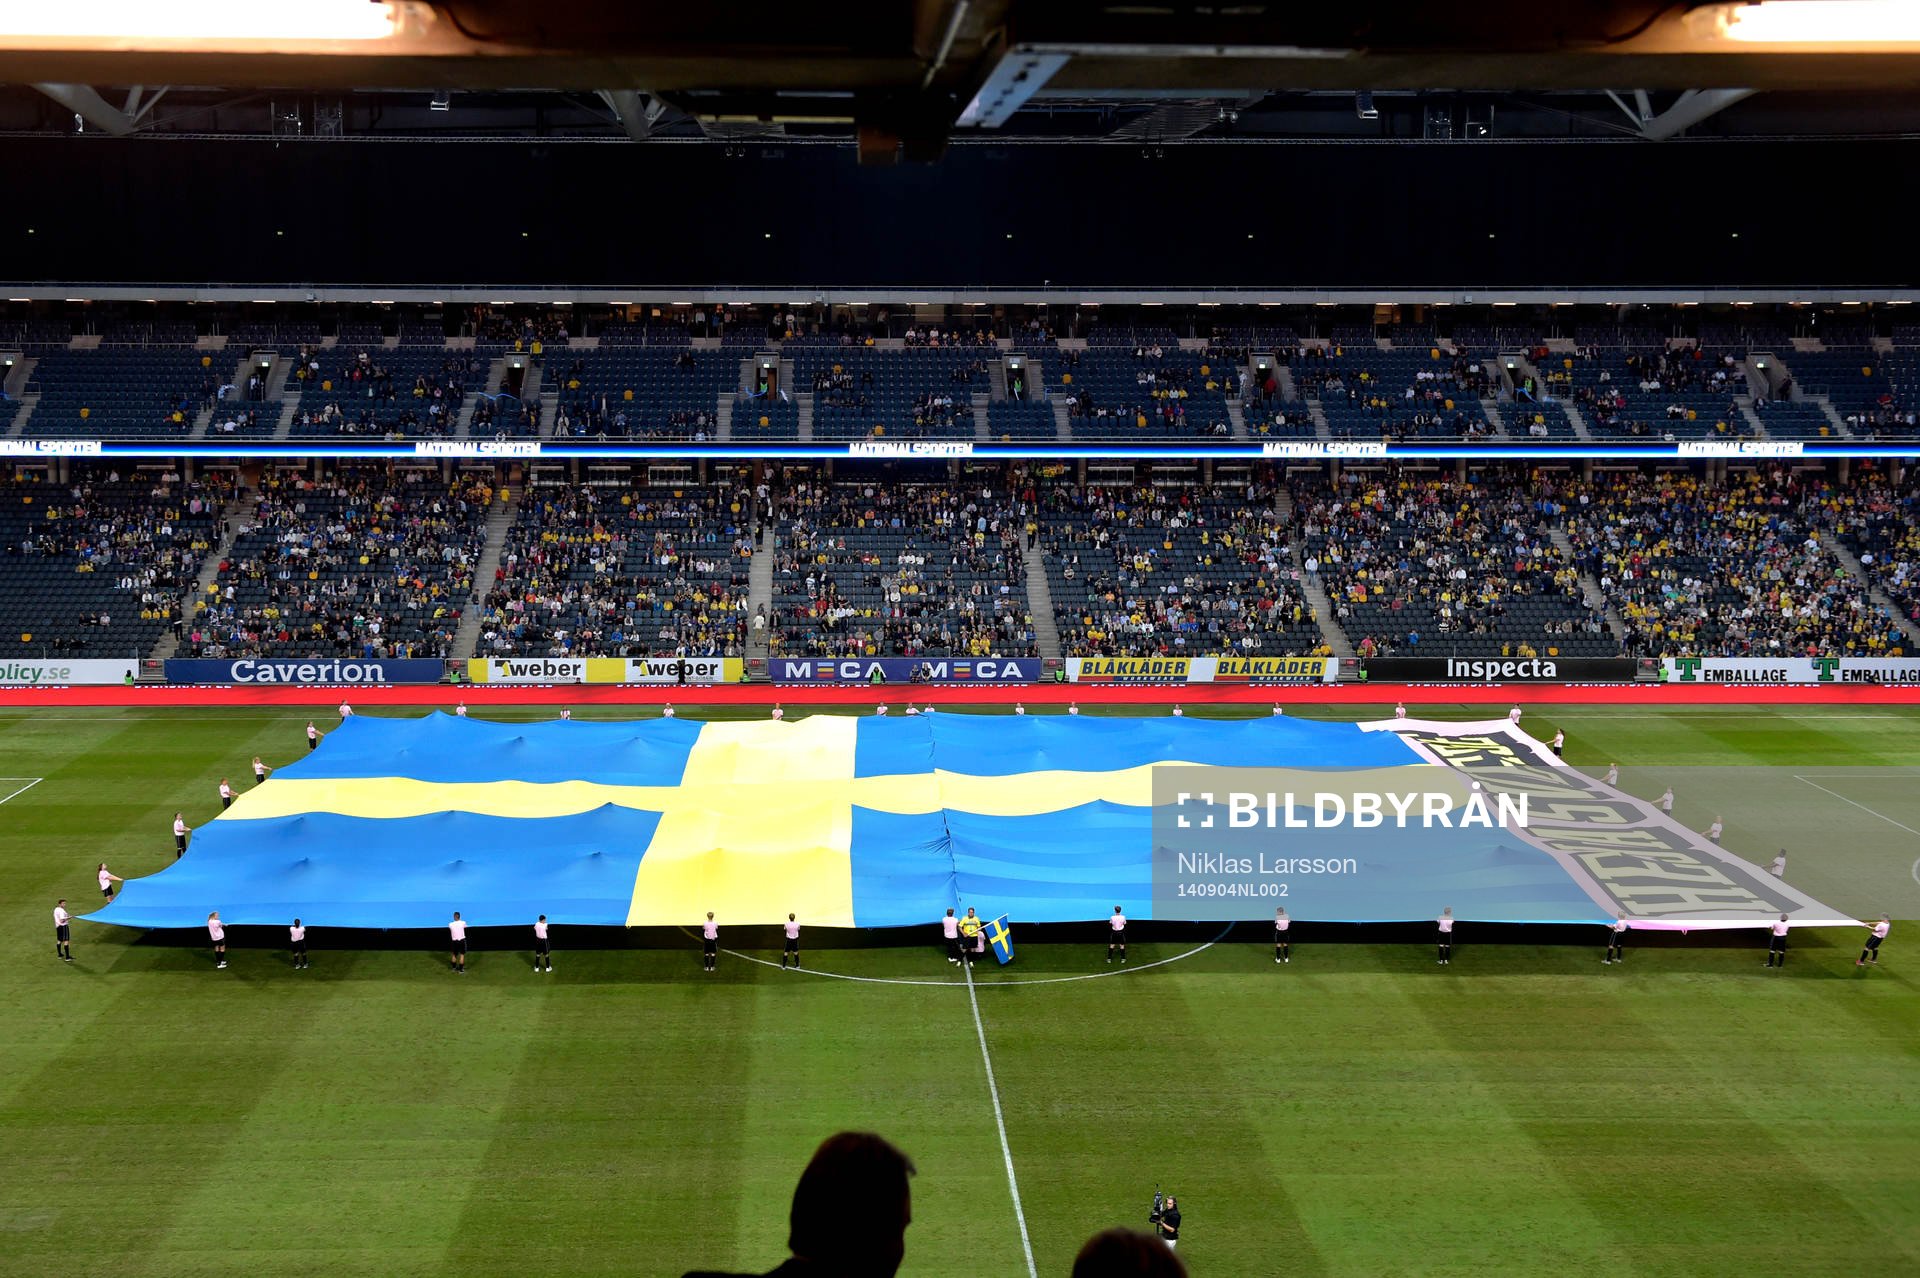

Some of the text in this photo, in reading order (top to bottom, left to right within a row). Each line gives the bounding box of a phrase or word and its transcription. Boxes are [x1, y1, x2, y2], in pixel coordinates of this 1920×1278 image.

[415, 442, 541, 455] NATIONALSPORTEN
[849, 442, 974, 456] NATIONALSPORTEN
[1263, 442, 1387, 456] NATIONALSPORTEN
[1677, 442, 1804, 456] NATIONALSPORTEN
[230, 659, 386, 683] Caverion
[509, 659, 582, 677] weber
[785, 661, 887, 679] MECA
[1081, 659, 1187, 675] BLÅKLÄDER
[1217, 658, 1323, 674] BLÅKLÄDER
[1446, 658, 1558, 681] Inspecta
[1703, 669, 1788, 682] EMBALLAGE
